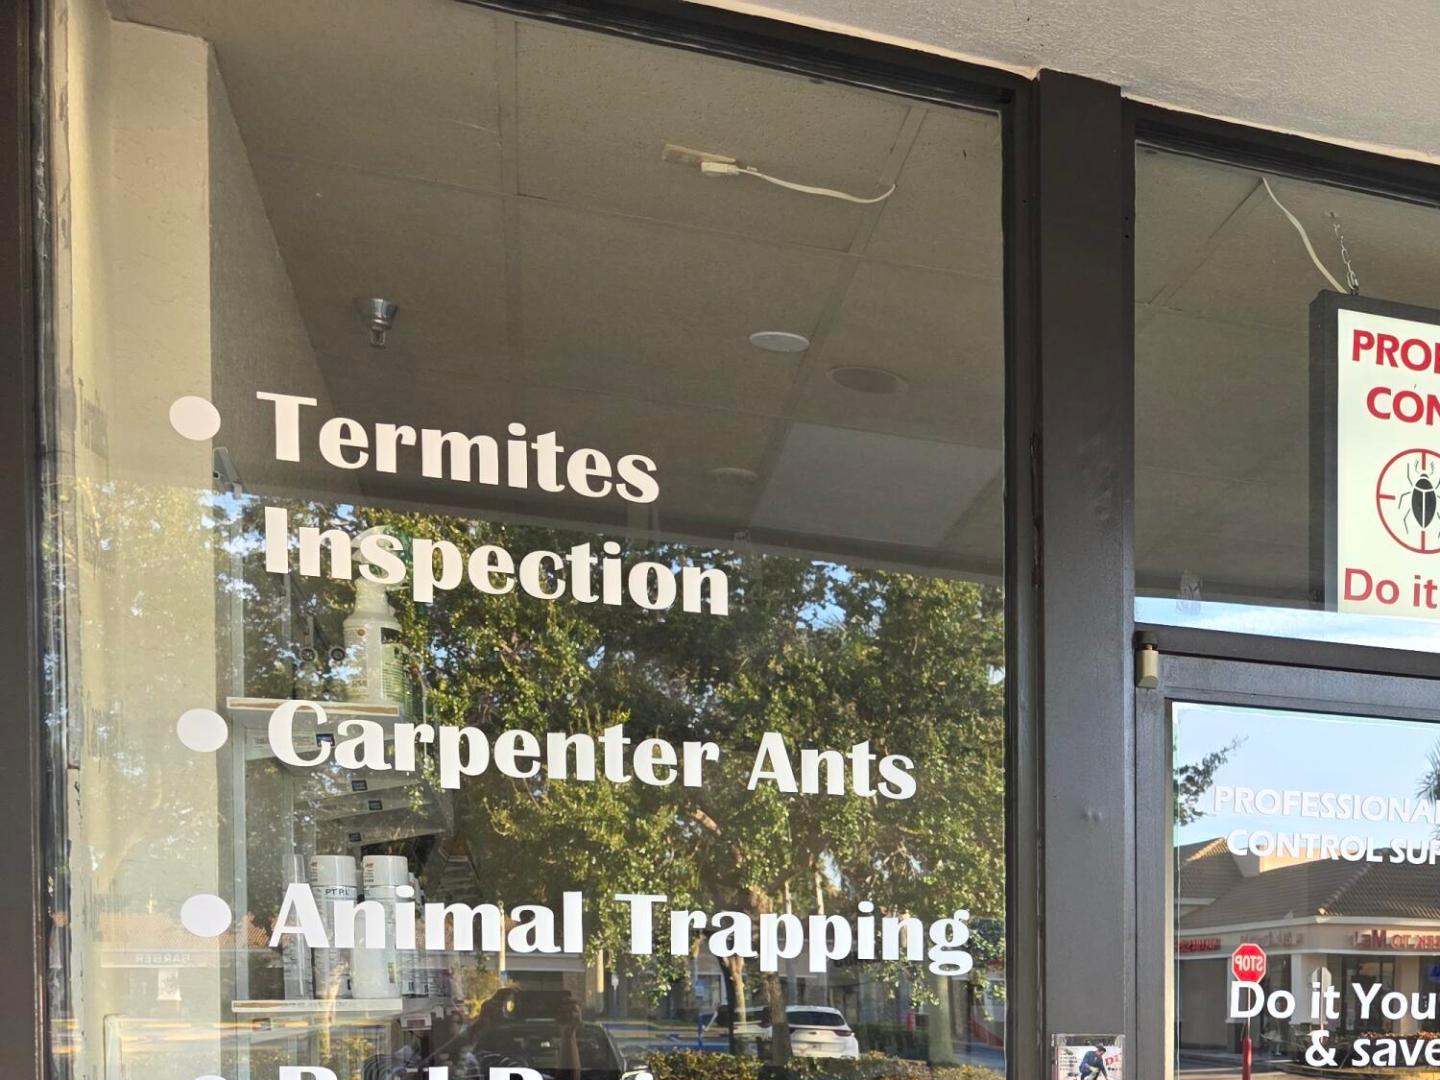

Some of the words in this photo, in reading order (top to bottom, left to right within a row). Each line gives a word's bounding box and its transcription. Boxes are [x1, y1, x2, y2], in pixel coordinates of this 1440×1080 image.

[256, 390, 661, 504] Termites
[264, 506, 730, 617] Inspection
[1343, 567, 1399, 605] Do
[1412, 574, 1438, 609] it
[268, 699, 719, 790] Carpenter
[747, 731, 917, 800] Ants
[1226, 829, 1384, 863] CONTROL
[268, 882, 585, 954] Animal
[614, 891, 972, 977] Trapping
[1230, 981, 1295, 1019] Do
[1310, 982, 1340, 1019] it
[1305, 1030, 1340, 1067] &
